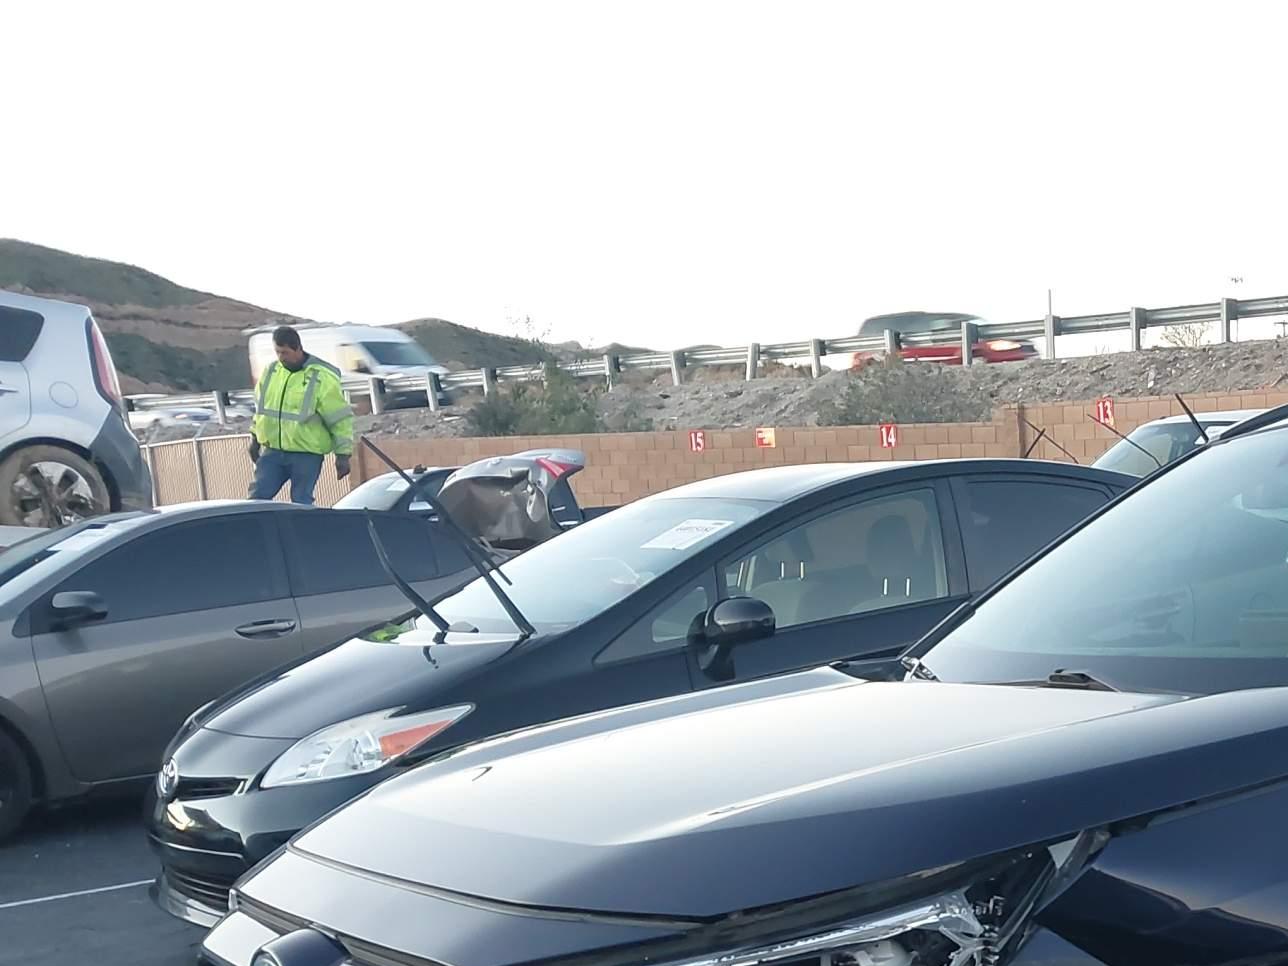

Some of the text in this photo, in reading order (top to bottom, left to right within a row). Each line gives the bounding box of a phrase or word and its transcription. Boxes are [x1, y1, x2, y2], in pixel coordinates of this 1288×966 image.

[1097, 400, 1115, 426] 13
[690, 432, 704, 452] 15
[880, 426, 897, 448] 14
